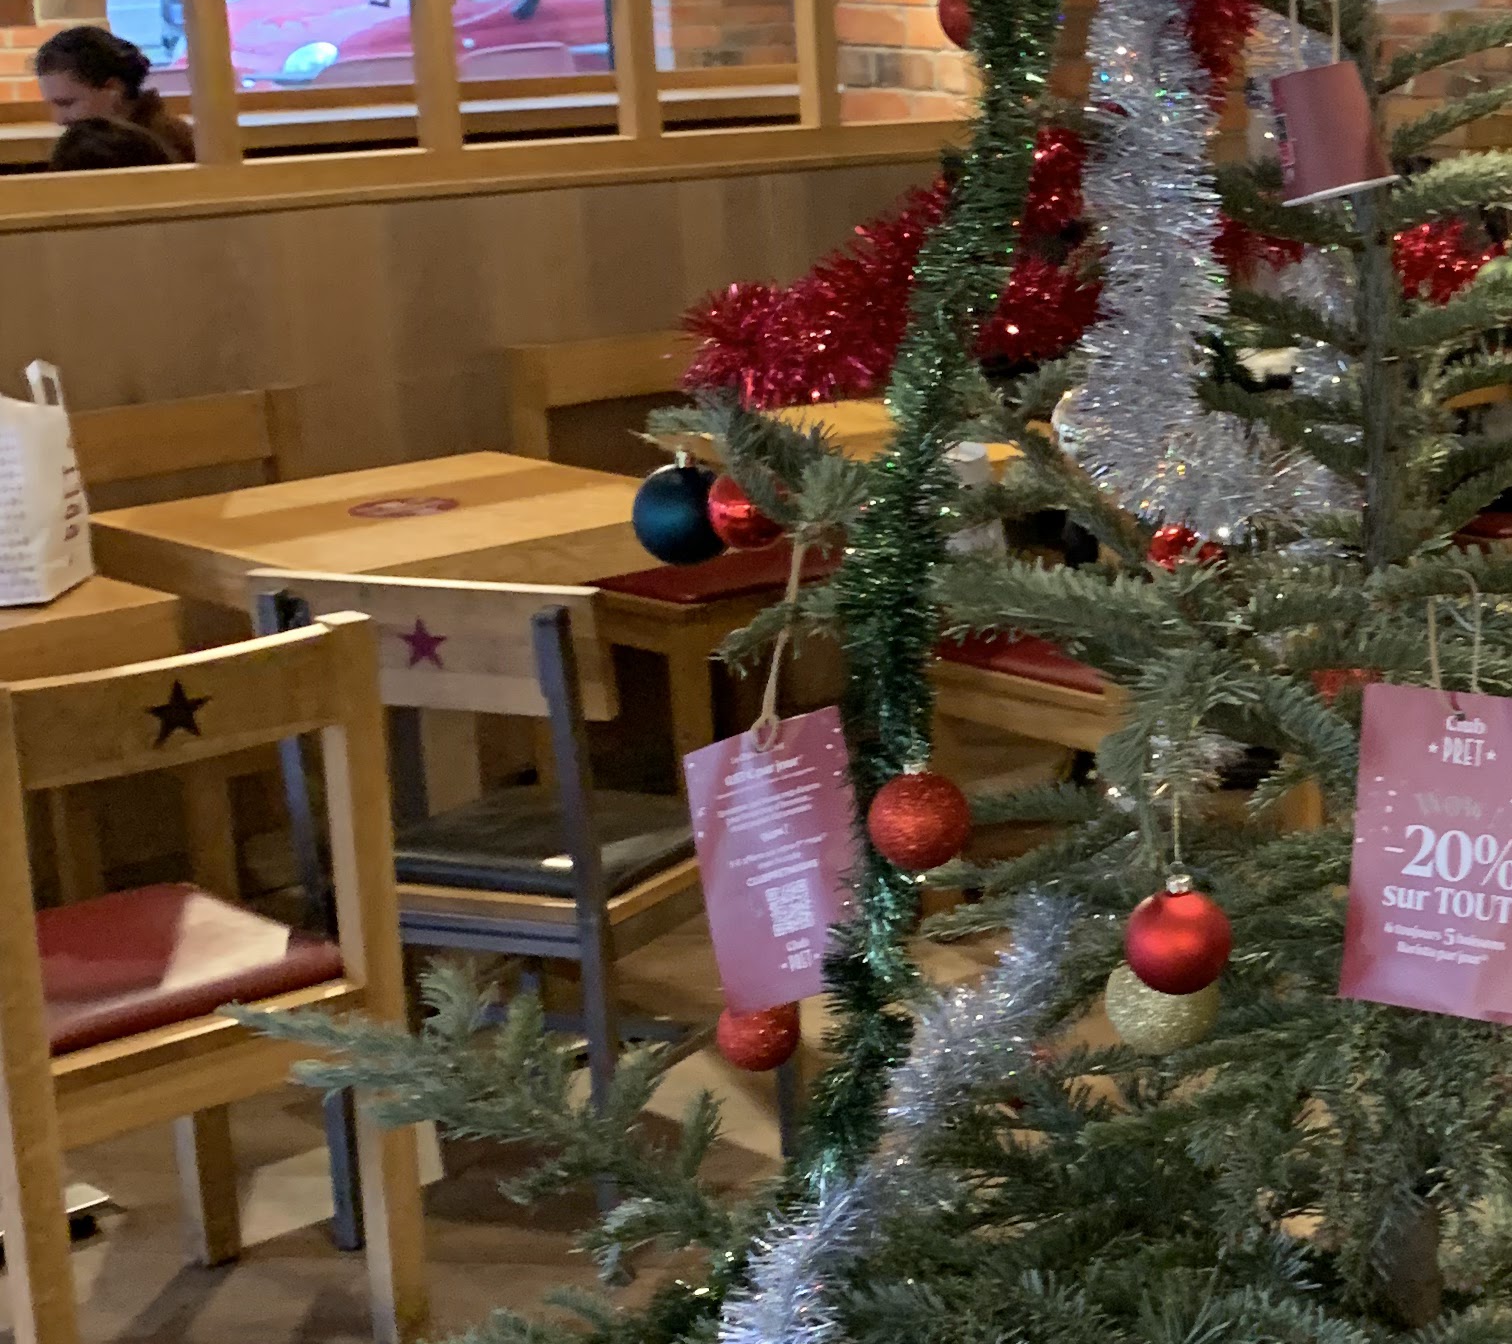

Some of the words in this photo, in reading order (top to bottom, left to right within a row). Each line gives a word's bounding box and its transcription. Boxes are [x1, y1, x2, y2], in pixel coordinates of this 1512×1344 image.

[1442, 736, 1485, 767] PRET
[1381, 885, 1431, 911] sur
[1443, 928, 1457, 946] 5
